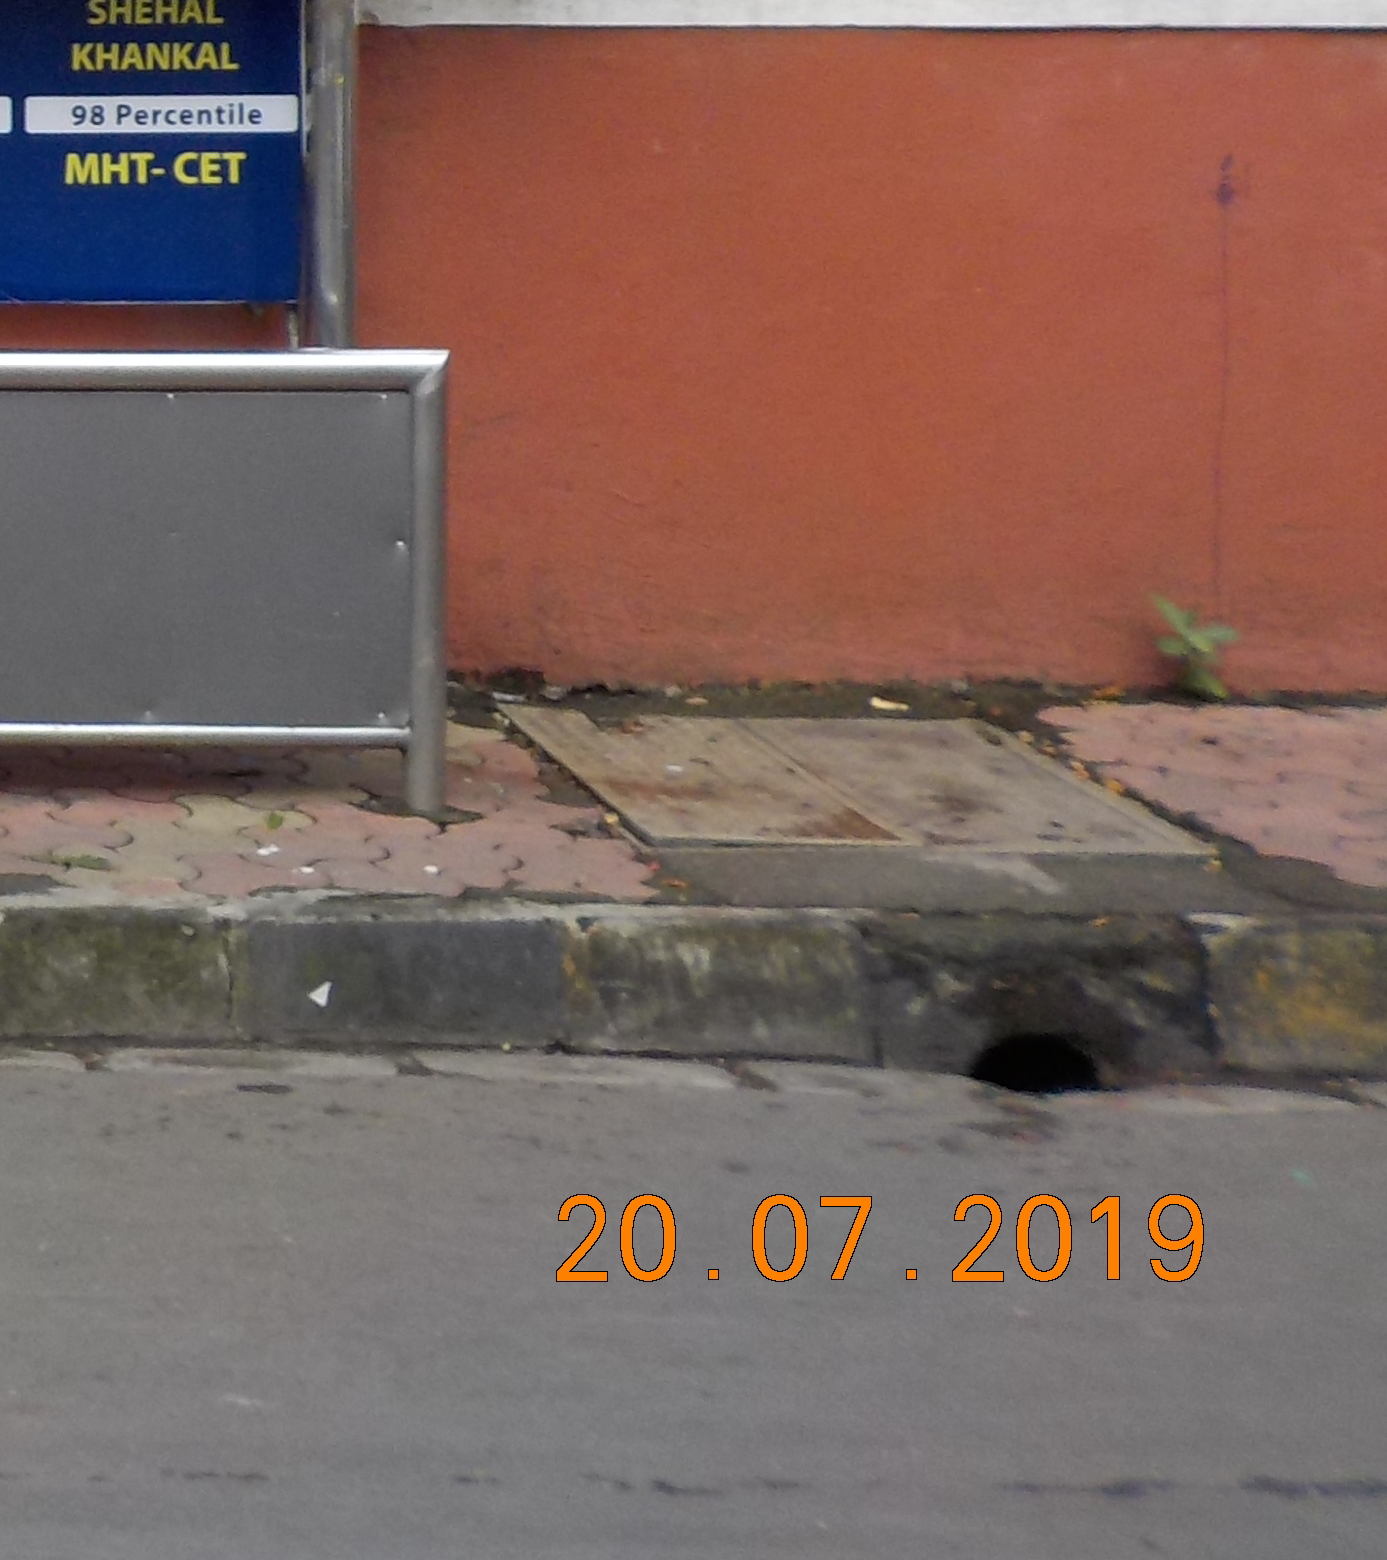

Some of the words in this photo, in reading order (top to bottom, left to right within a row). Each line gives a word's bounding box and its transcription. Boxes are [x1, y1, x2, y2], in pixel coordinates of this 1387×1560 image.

[70, 42, 239, 71] KHANKAL
[70, 104, 105, 126] 98
[115, 102, 263, 127] Percentile
